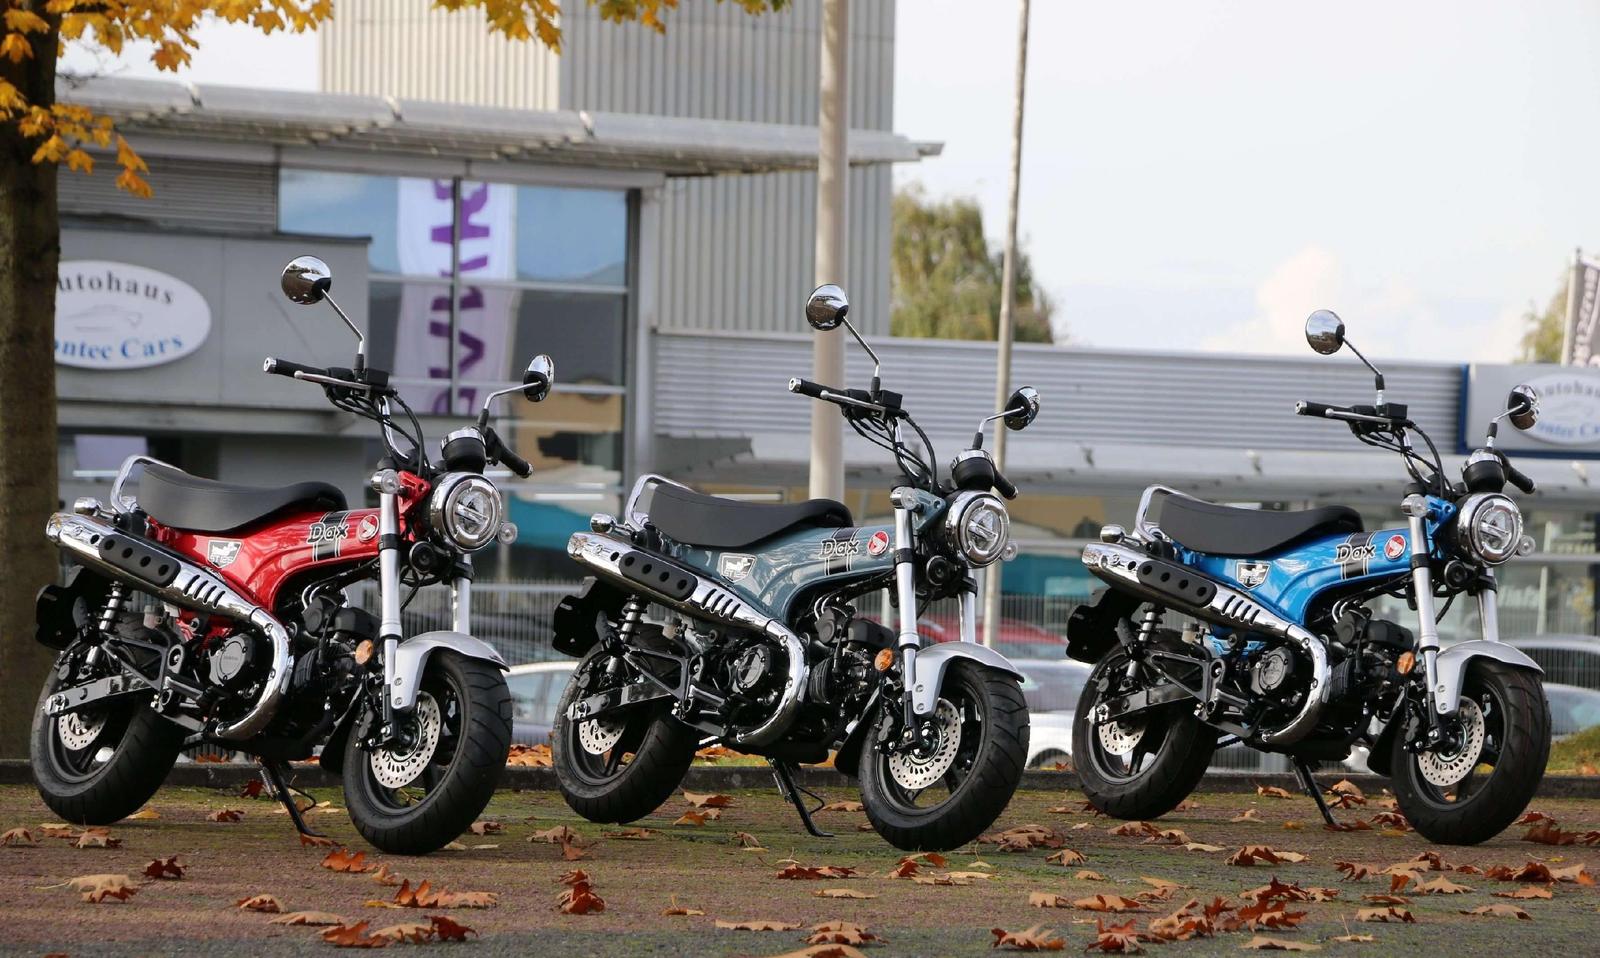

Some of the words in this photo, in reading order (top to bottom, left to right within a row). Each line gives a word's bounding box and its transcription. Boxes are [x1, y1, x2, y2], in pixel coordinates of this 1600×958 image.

[58, 271, 173, 304] utohaus
[120, 334, 184, 359] Cars
[307, 522, 349, 544] Dax
[820, 538, 860, 559] Dax
[1334, 543, 1375, 564] Dax
